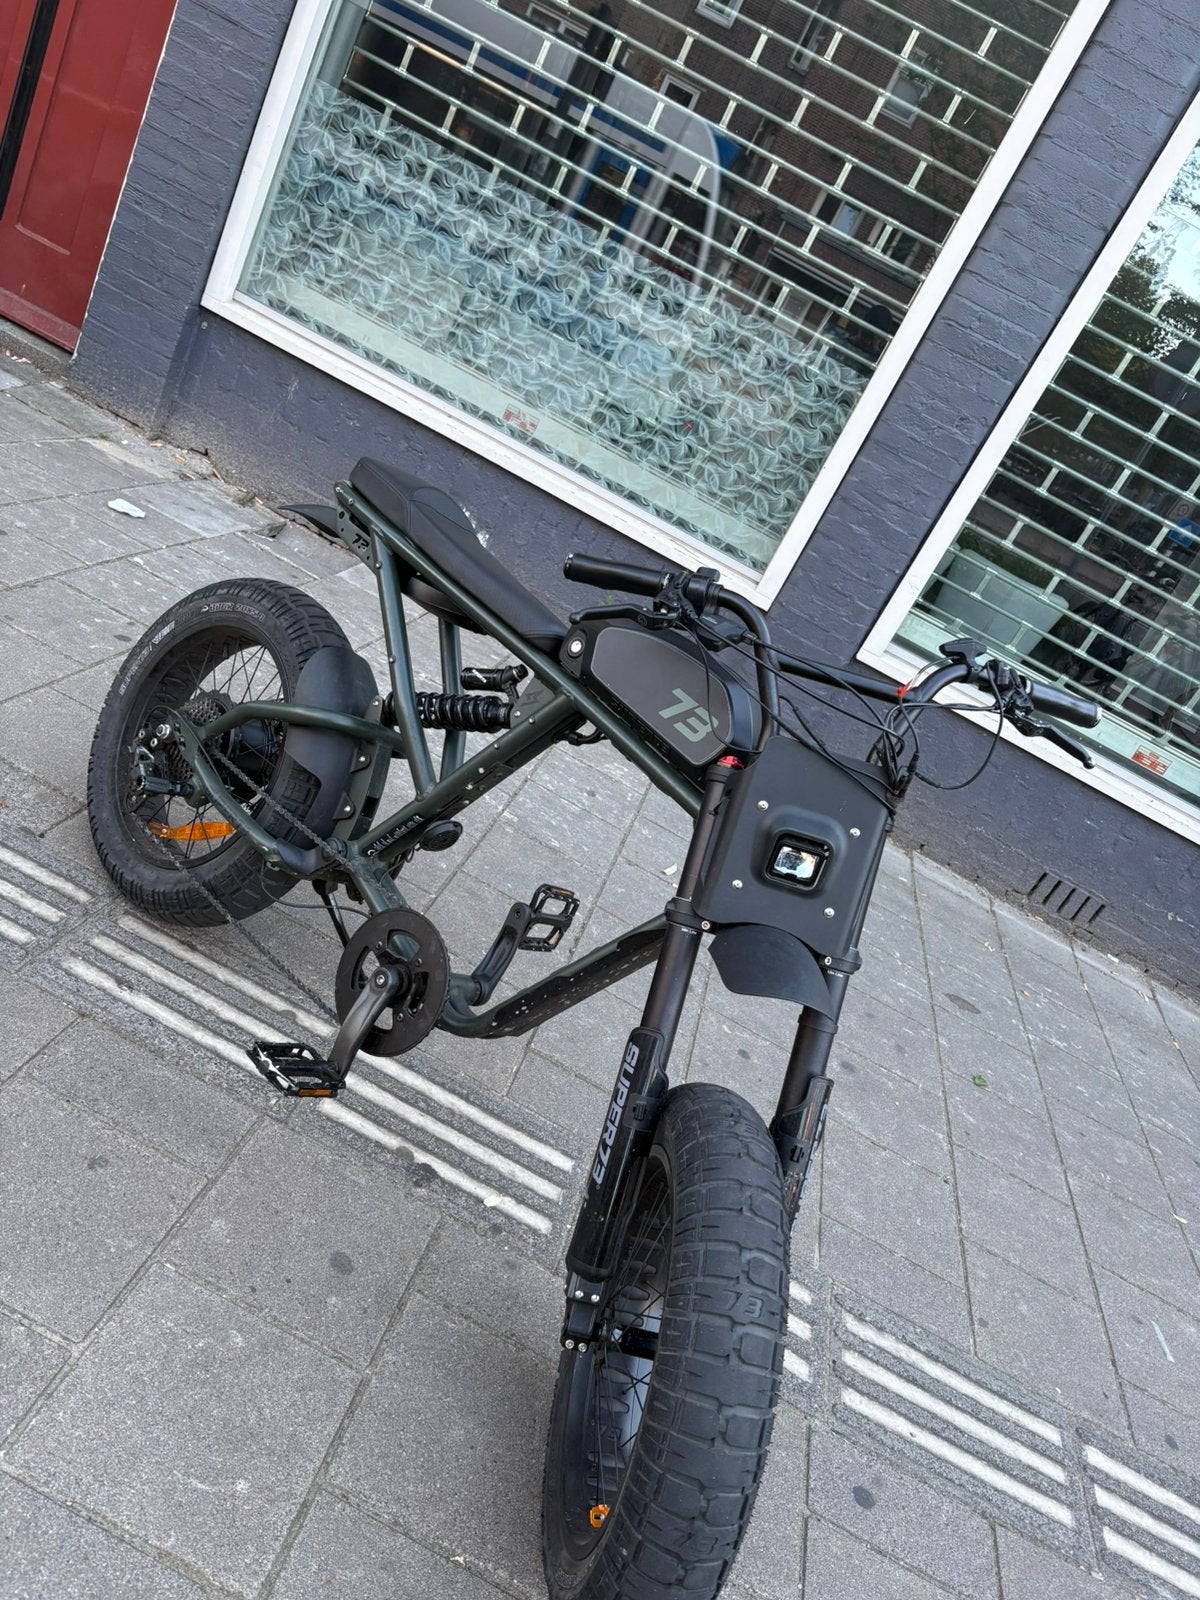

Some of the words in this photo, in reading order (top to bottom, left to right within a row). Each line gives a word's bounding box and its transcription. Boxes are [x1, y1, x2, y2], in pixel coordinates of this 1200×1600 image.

[658, 688, 719, 743] 73
[593, 1042, 640, 1185] SUPER73
[722, 1288, 765, 1319] 73
